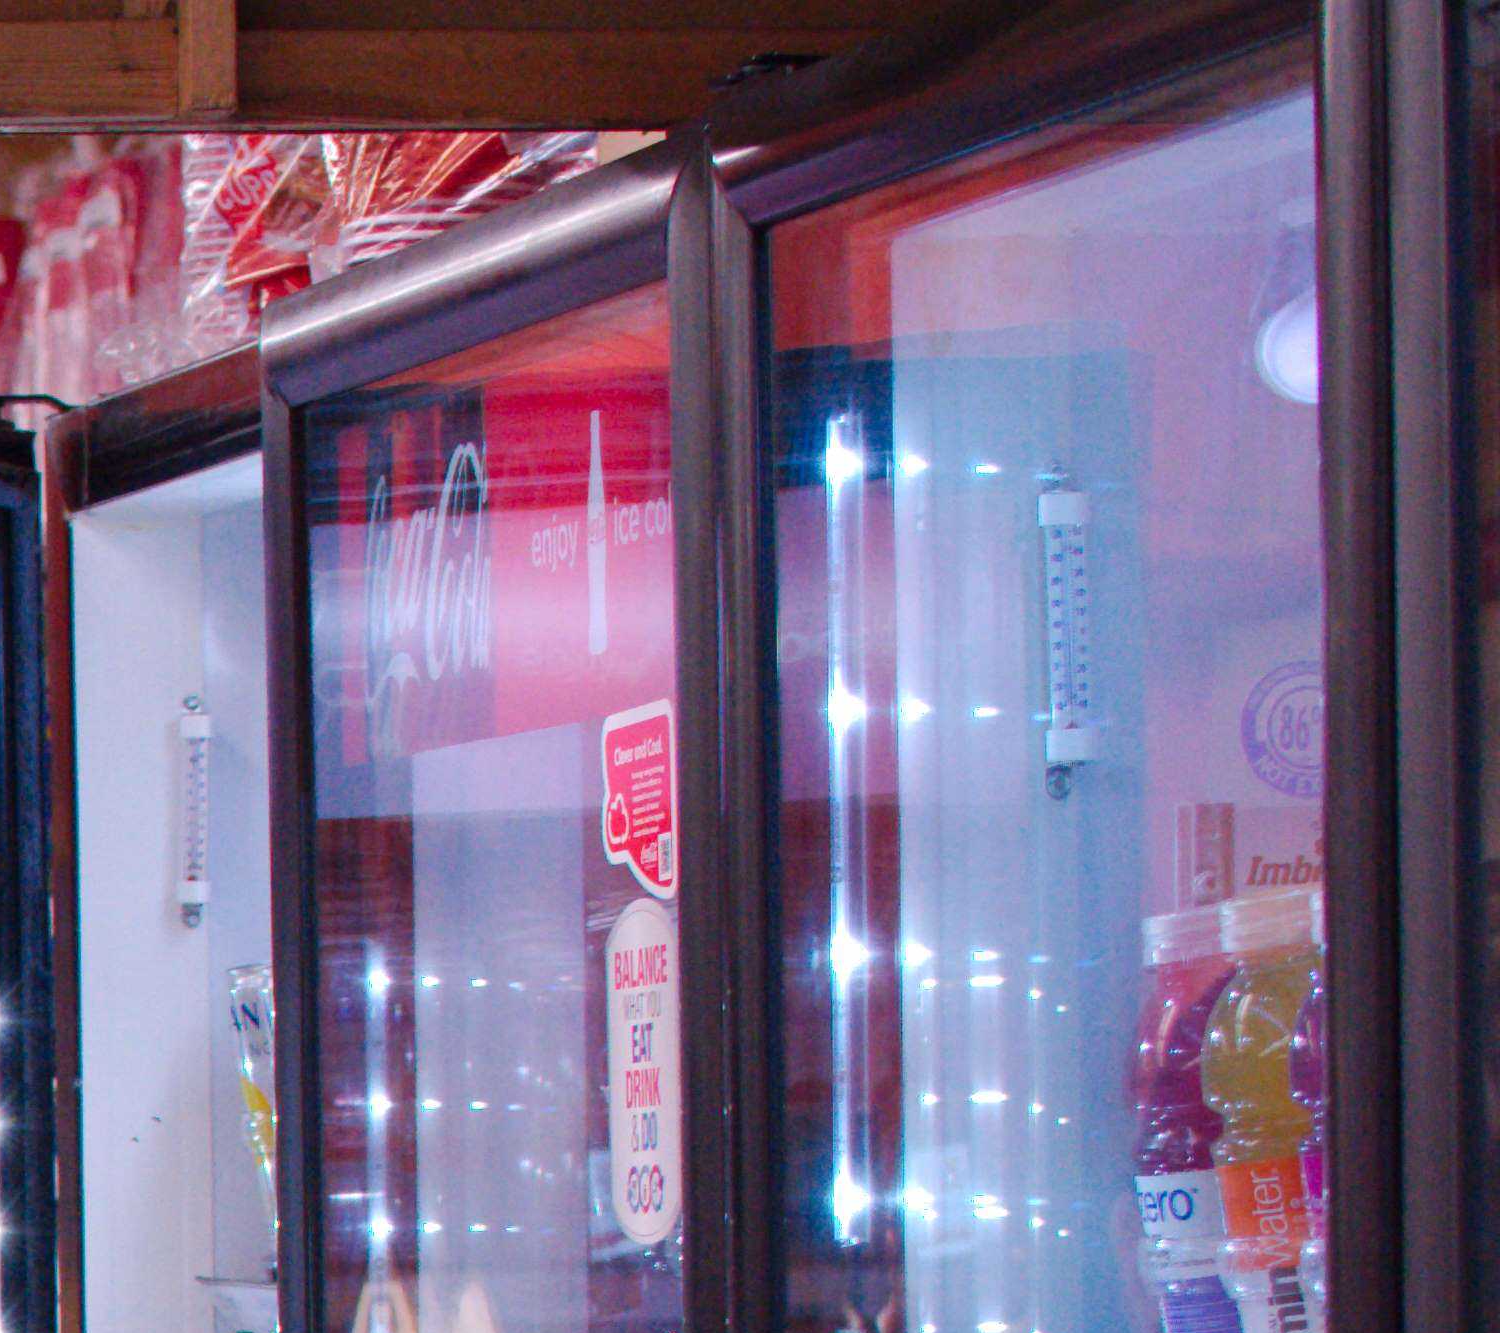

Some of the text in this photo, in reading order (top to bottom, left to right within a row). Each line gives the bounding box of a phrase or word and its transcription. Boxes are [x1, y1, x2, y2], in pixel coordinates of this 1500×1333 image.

[532, 514, 580, 572] enjoy
[613, 497, 640, 546] ice
[614, 943, 668, 990] BALANCE
[631, 1022, 654, 1064] EAT
[625, 1067, 661, 1109] DRINK
[641, 1112, 658, 1150] DO
